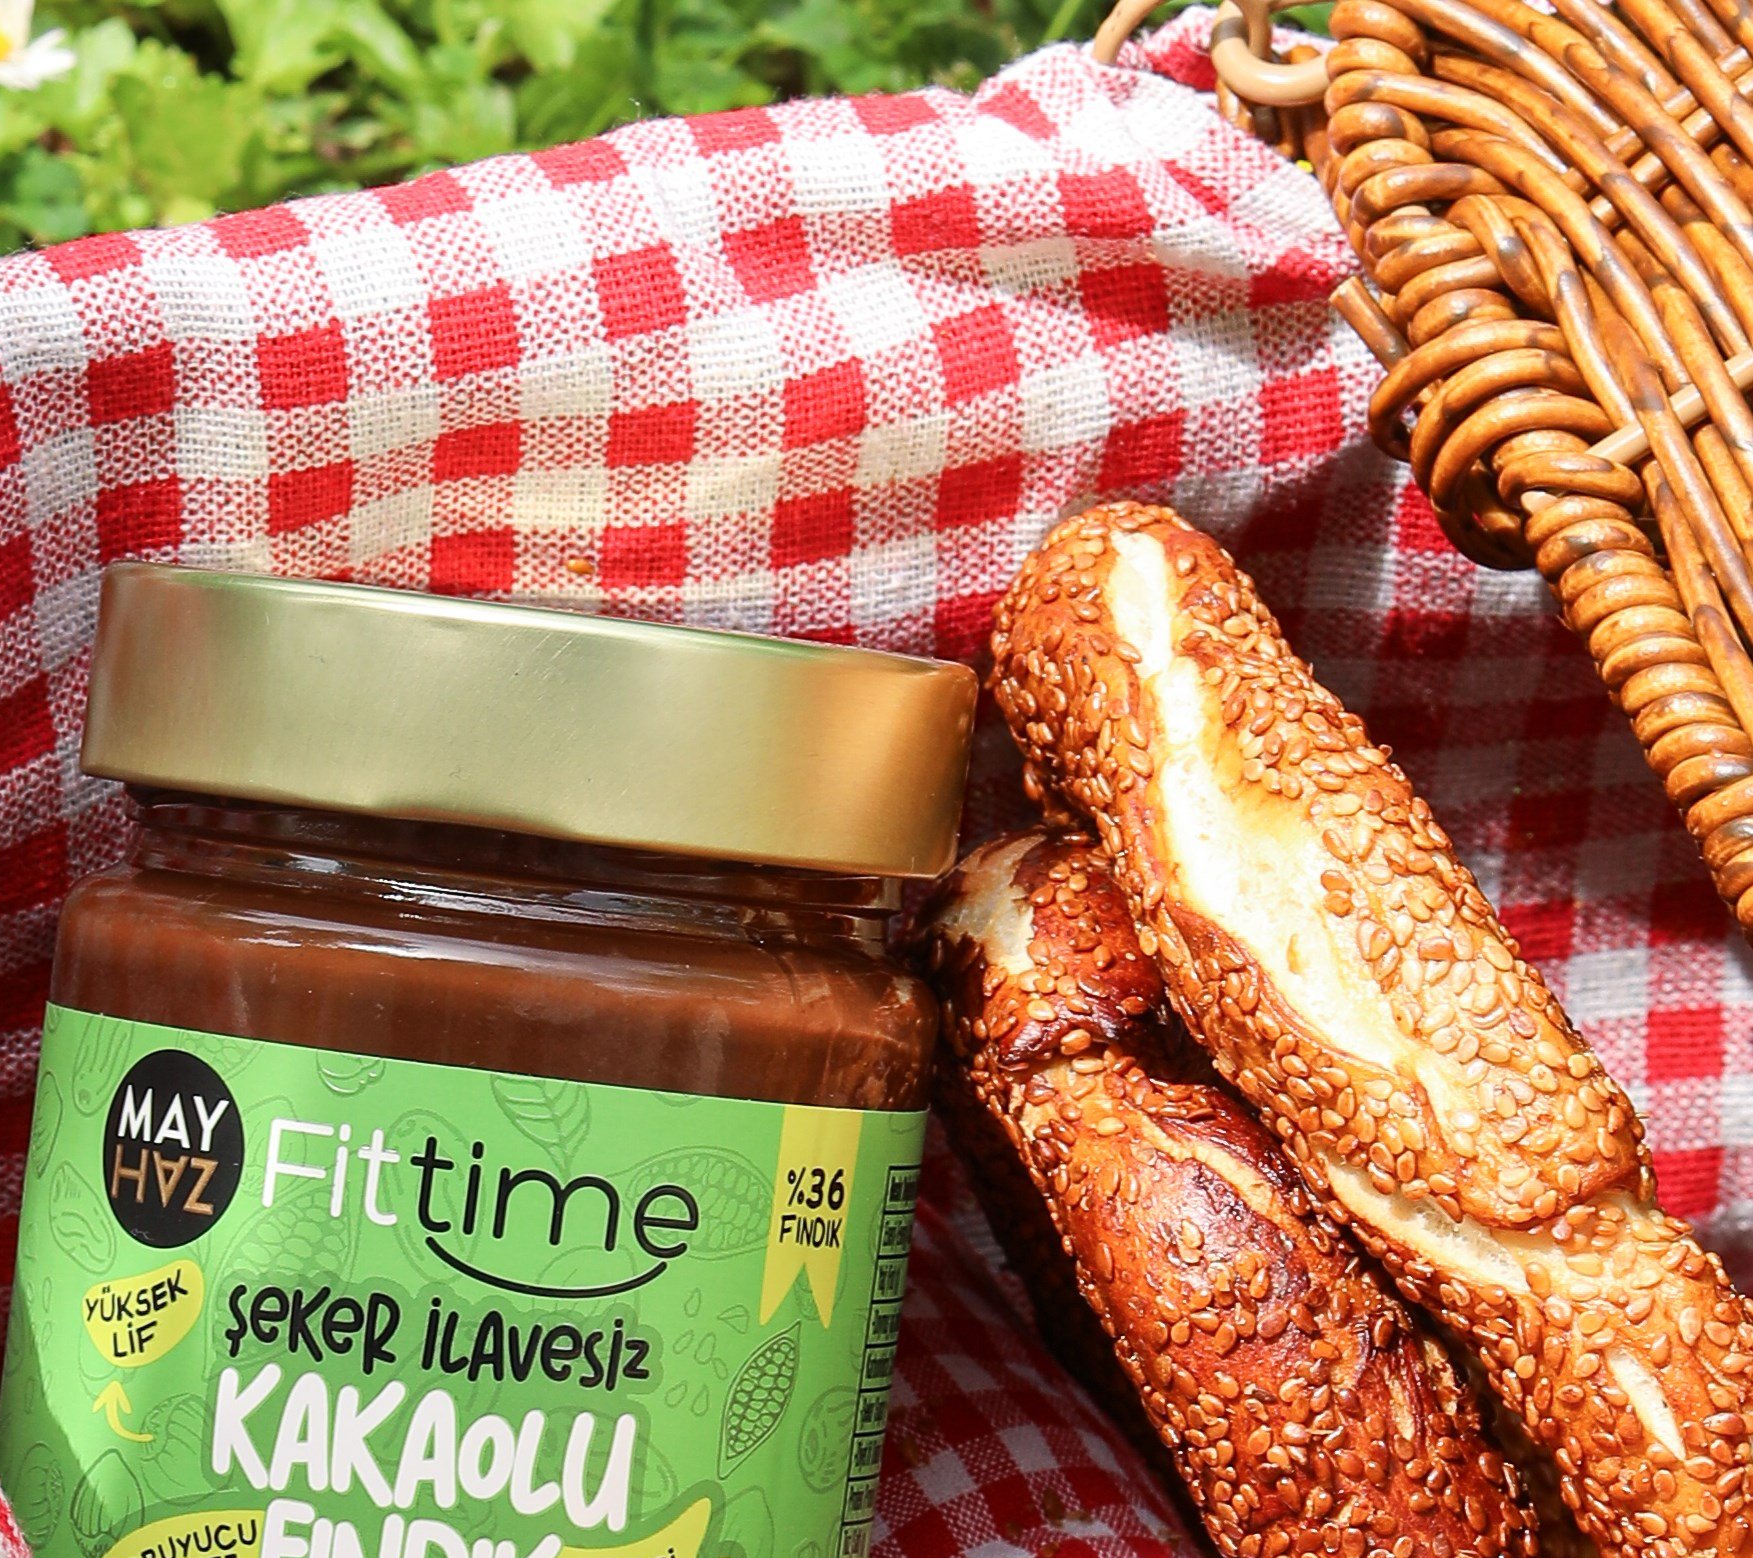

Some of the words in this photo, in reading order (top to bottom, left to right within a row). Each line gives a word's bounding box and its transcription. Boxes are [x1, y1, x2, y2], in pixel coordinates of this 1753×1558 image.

[117, 1084, 230, 1152] MAY
[787, 1166, 845, 1211] %36
[778, 1214, 843, 1248] FINDIK
[84, 1269, 189, 1323] YÜKSEK
[111, 1319, 158, 1359] LİF
[211, 1362, 637, 1532] KAKAOLU
